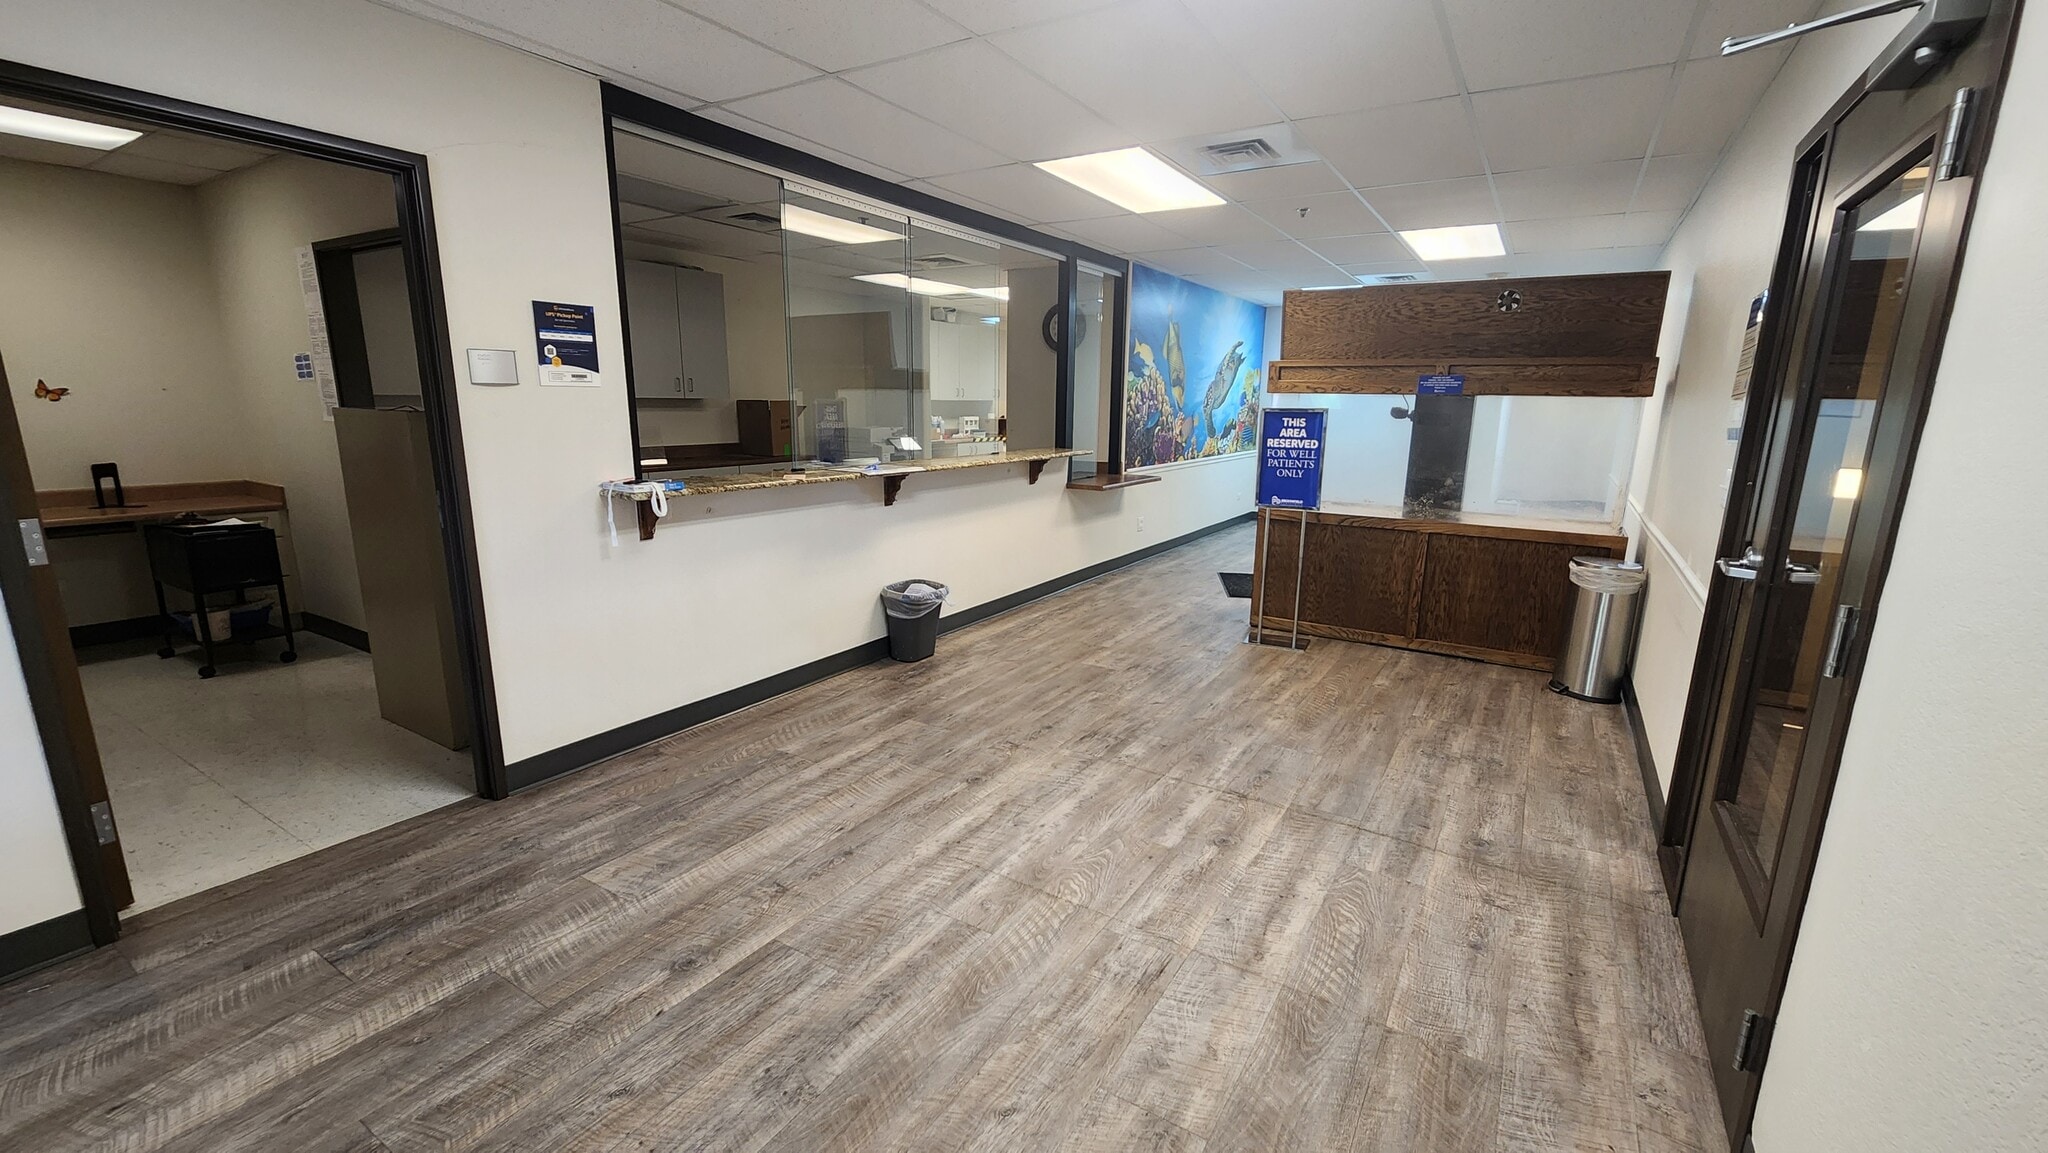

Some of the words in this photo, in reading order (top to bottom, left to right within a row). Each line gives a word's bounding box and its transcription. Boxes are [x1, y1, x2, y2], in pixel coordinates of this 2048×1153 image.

[1282, 417, 1306, 427] THIS
[1279, 428, 1307, 438] AREA
[1267, 438, 1319, 449] RESERVED
[1267, 448, 1287, 458] FOR
[1289, 449, 1317, 459] WELL
[1267, 458, 1315, 469] PATIENTS
[1276, 468, 1304, 478] ONLY
